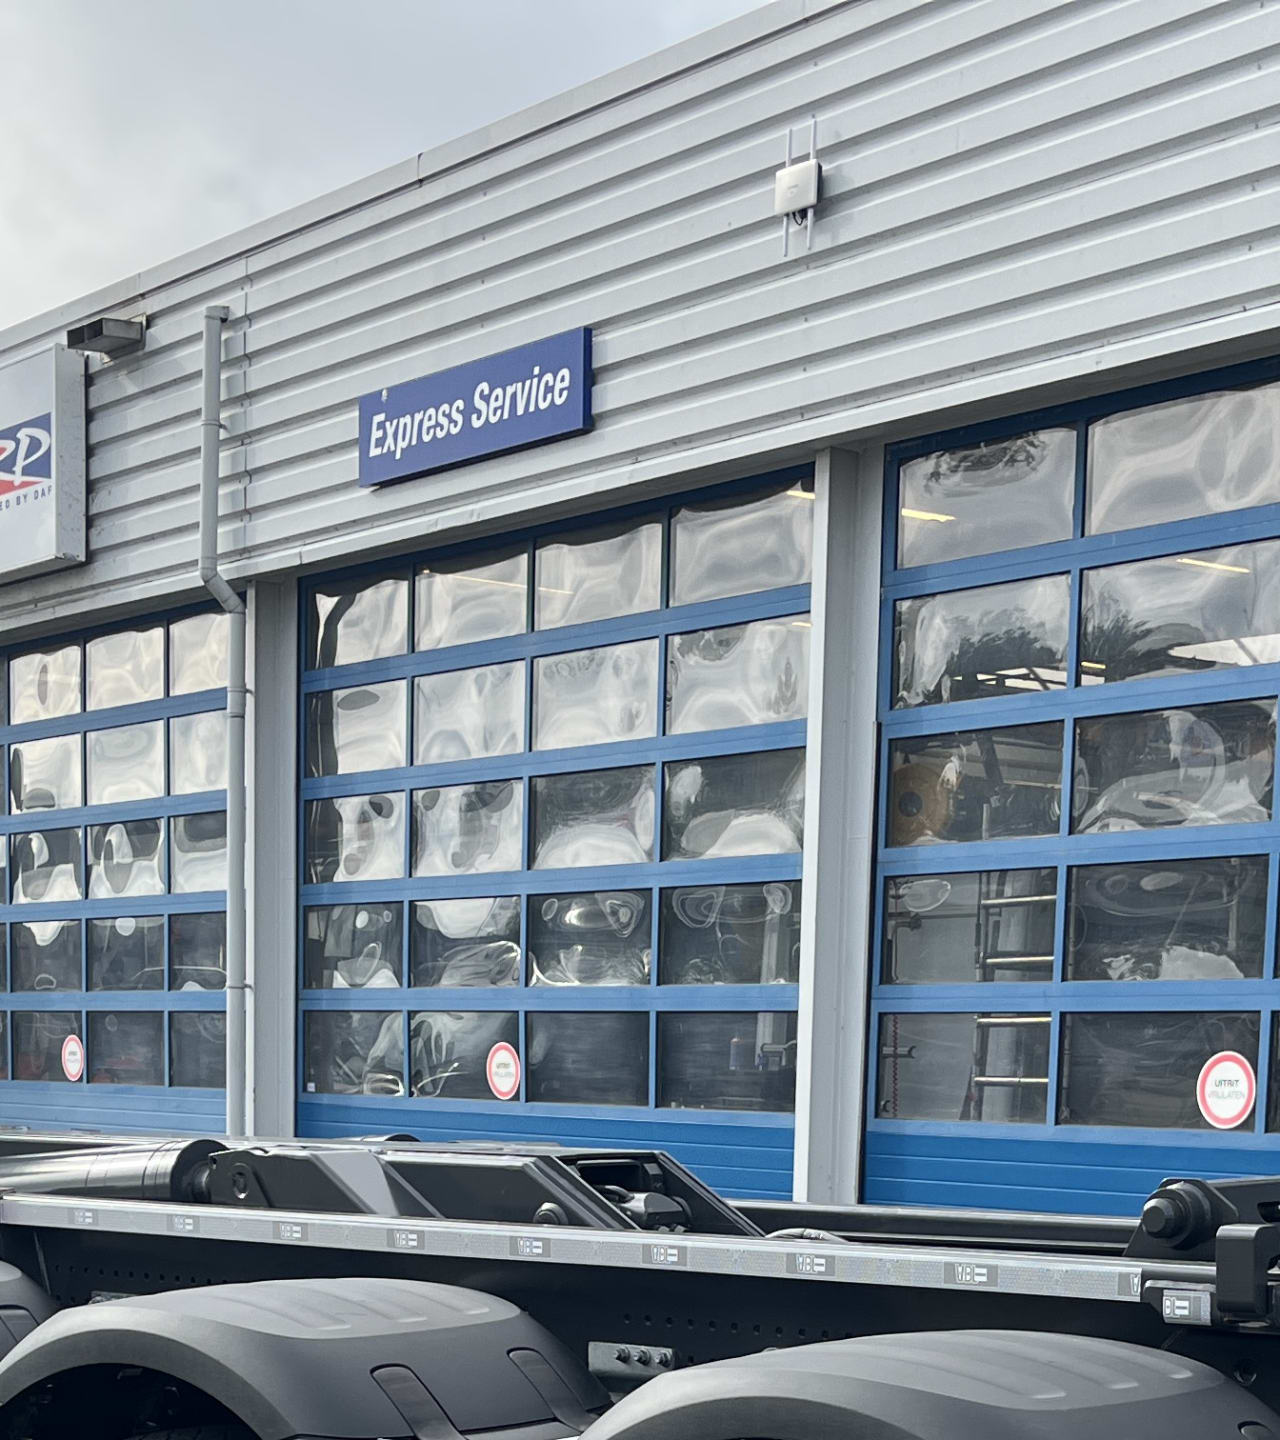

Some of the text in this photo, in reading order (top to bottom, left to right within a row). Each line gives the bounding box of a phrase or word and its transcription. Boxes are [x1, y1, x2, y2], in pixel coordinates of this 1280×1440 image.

[368, 365, 571, 460] Express Service
[15, 493, 29, 506] BY
[33, 485, 53, 500] DAF
